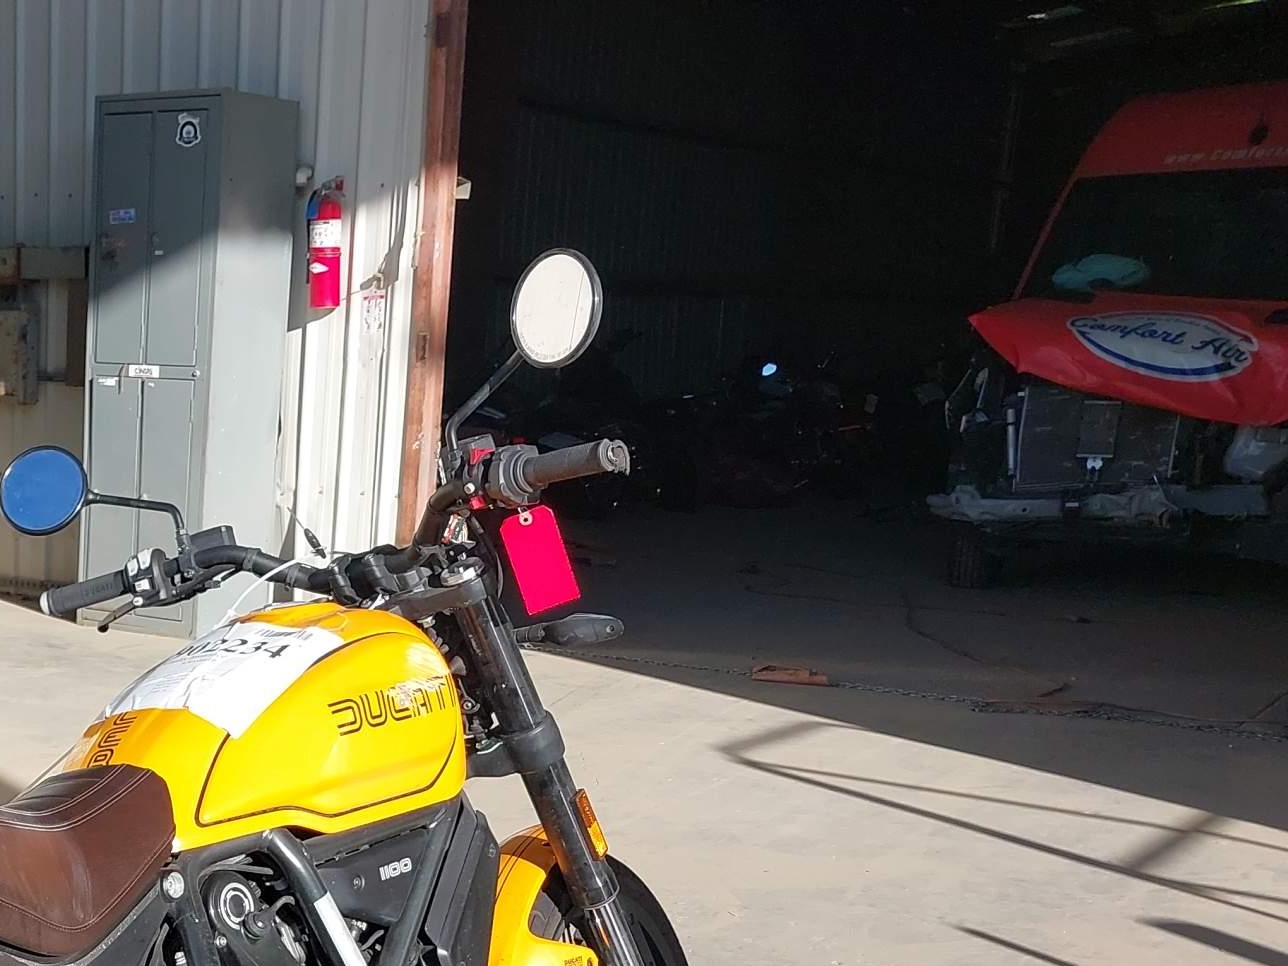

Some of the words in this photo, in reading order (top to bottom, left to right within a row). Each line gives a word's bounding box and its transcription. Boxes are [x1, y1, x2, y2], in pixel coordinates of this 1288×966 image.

[1070, 317, 1186, 345] Comfort
[1192, 336, 1249, 363] Air
[327, 673, 457, 736] DUCATI
[378, 857, 413, 881] 1100
